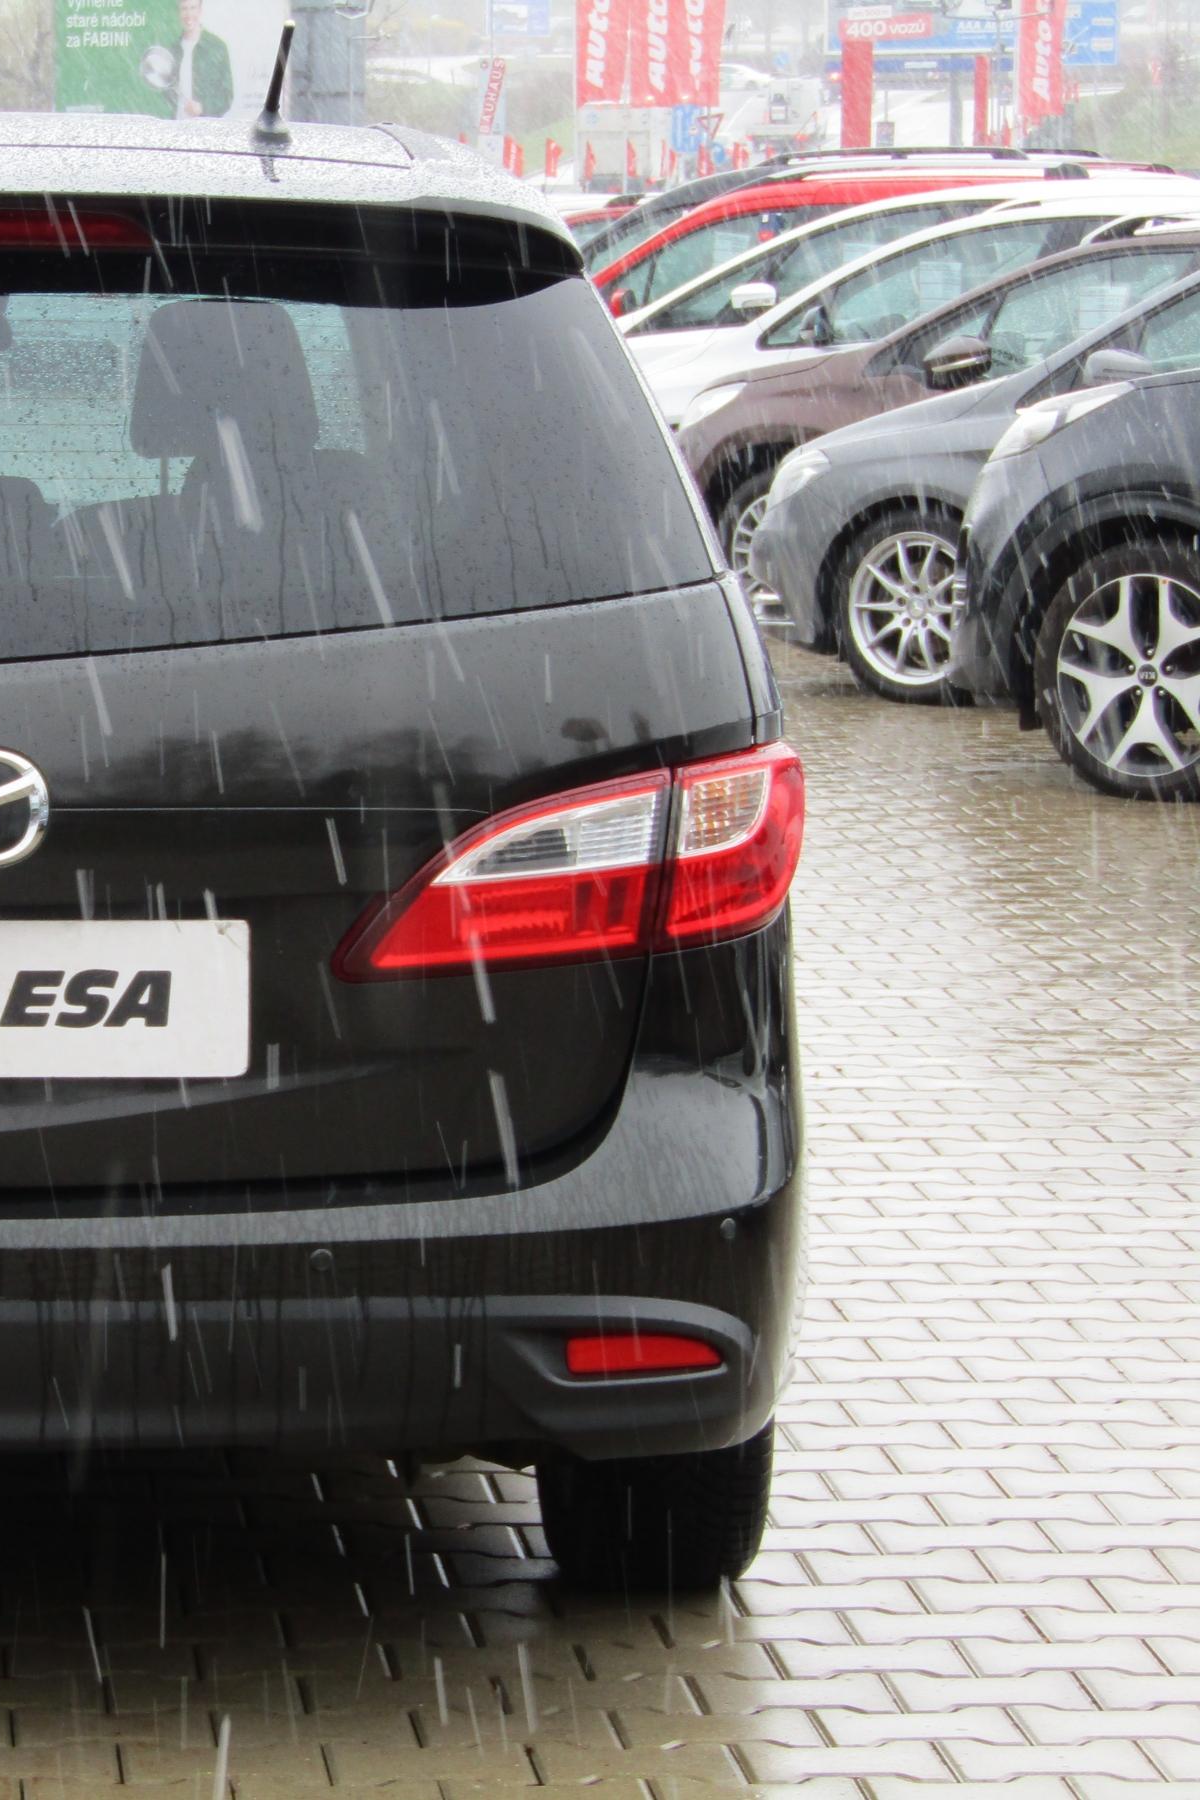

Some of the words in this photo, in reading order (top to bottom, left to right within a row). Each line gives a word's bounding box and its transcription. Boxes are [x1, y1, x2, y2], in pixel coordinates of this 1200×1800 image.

[66, 35, 81, 48] za
[846, 19, 887, 37] 400
[1032, 20, 1053, 102] Auto
[480, 58, 505, 134] BAUHAUS
